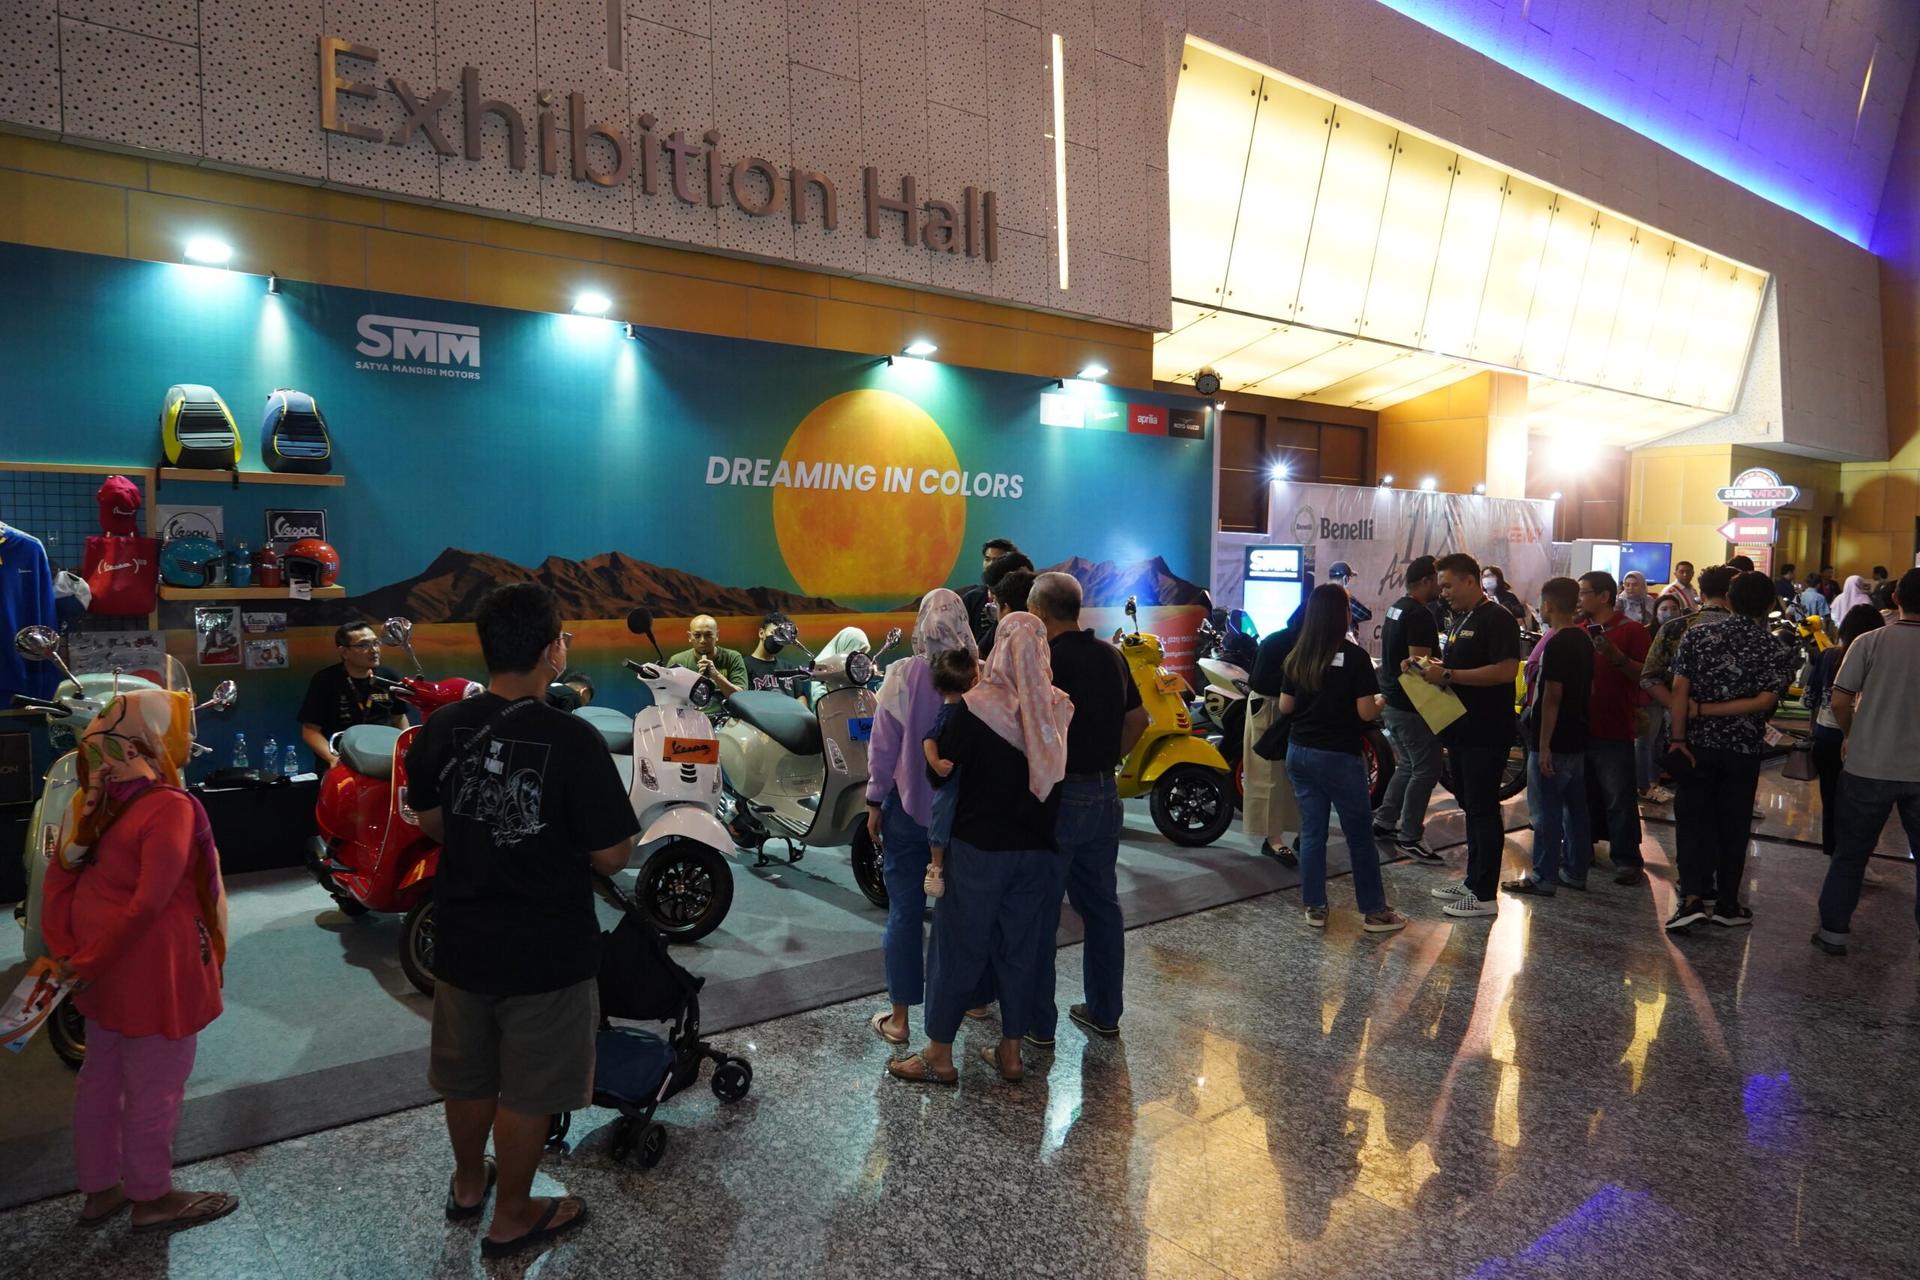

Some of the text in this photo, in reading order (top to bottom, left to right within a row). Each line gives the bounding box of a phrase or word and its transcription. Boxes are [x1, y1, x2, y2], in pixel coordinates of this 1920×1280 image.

[319, 34, 998, 263] Exhibition Hall
[355, 314, 481, 368] SMM
[355, 361, 481, 380] SATYA MANDIRI MOTORS
[1137, 415, 1158, 425] aprilia
[705, 455, 1025, 499] DREAMING IN COLORS
[273, 516, 320, 539] Vespa
[1320, 517, 1374, 540] Benelli
[671, 740, 712, 756] Vespa
